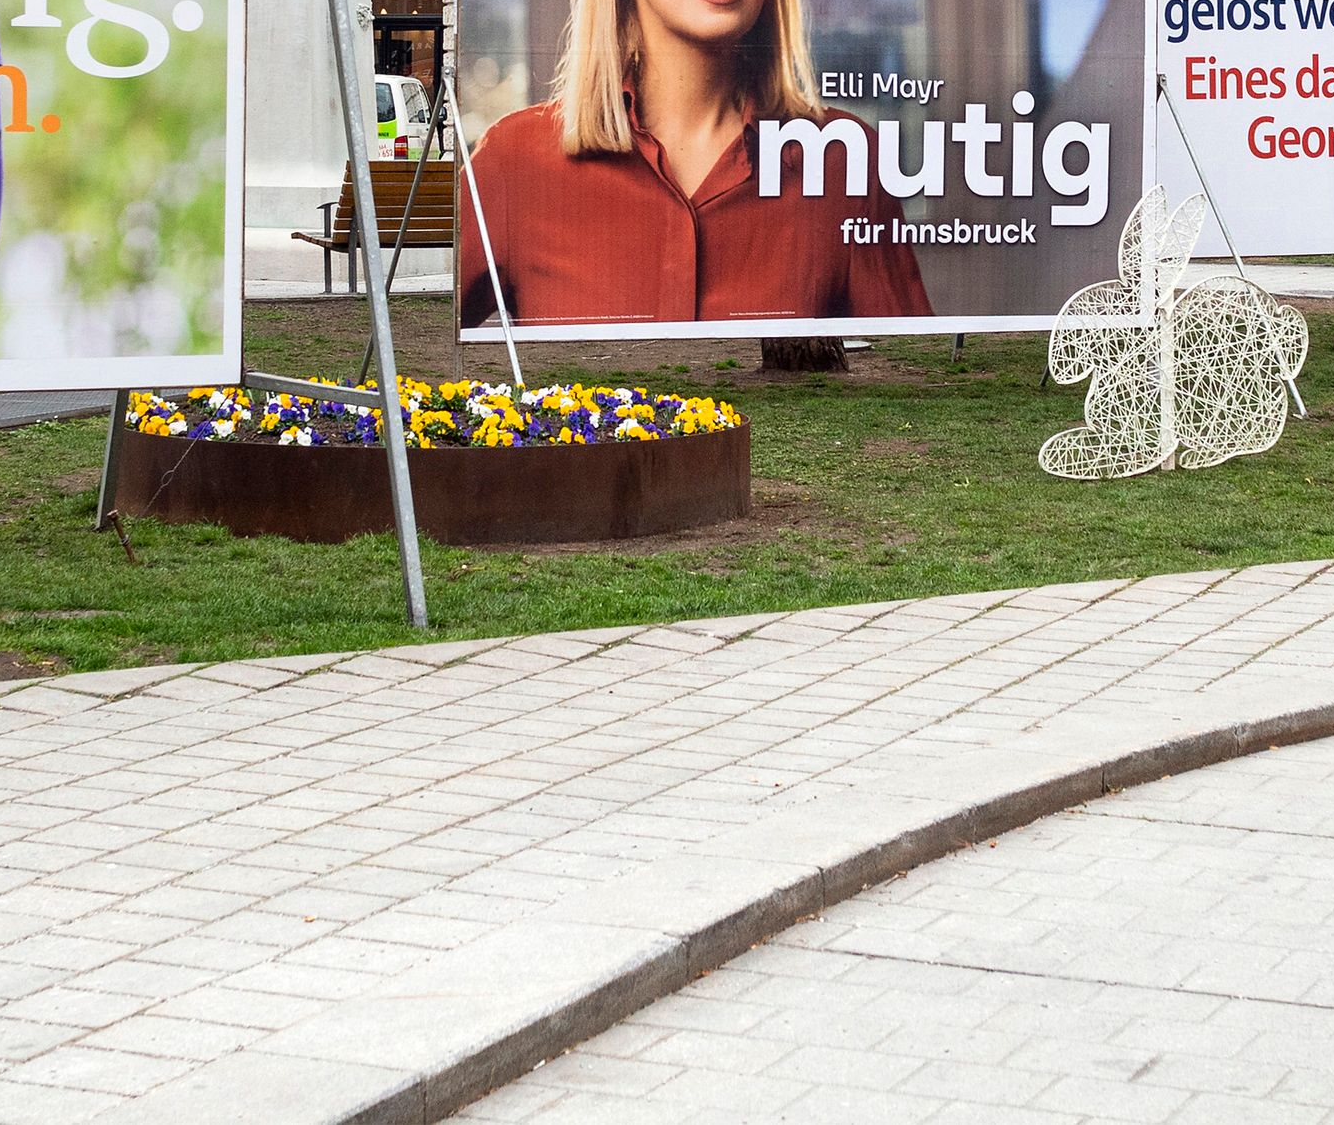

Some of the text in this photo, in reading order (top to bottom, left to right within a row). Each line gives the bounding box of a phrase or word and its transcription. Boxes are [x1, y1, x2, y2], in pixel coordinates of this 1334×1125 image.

[821, 71, 945, 105] Elli Mayr
[1184, 56, 1287, 101] Eines
[758, 90, 1111, 226] mutig
[840, 218, 1037, 245] für Innsbruck
